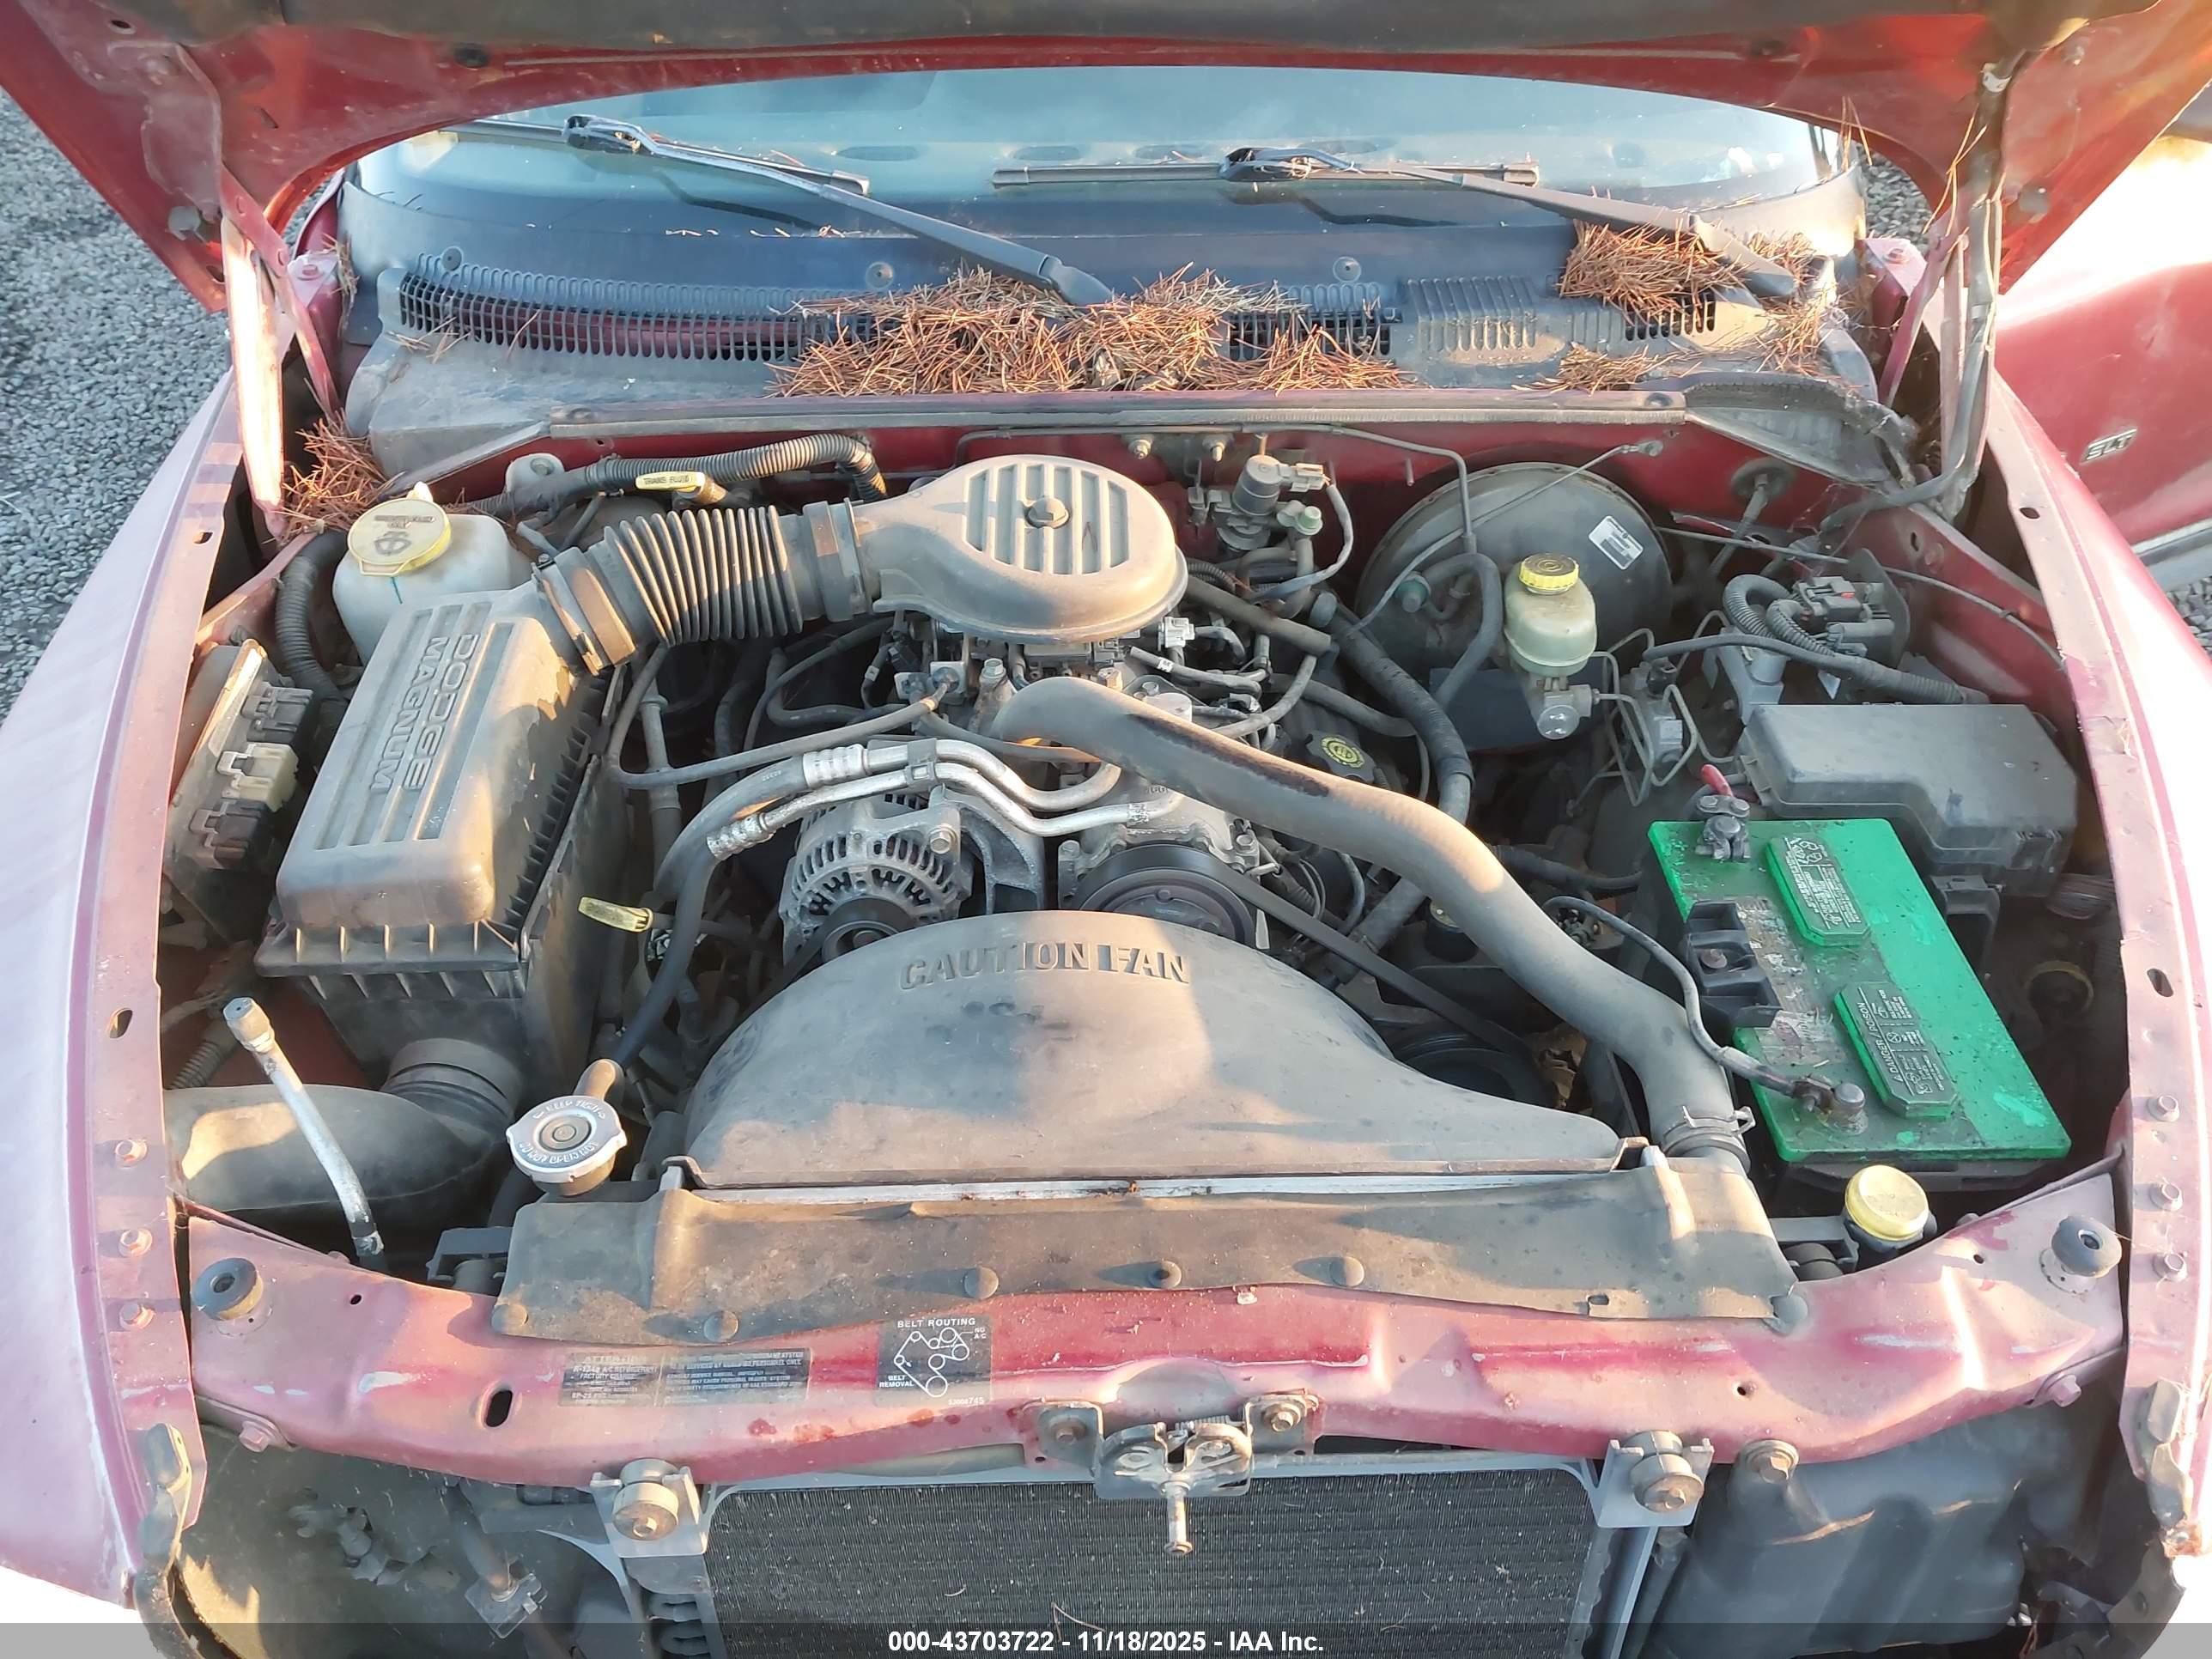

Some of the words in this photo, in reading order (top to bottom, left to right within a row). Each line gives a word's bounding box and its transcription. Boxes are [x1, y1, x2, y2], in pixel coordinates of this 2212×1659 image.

[369, 636, 450, 794] MAGNUM
[402, 634, 481, 791] DODGE
[901, 941, 1091, 990] CAUTION
[1096, 943, 1190, 985] FAN
[1856, 1002, 1879, 1032] POISON
[1875, 1038, 1899, 1074] DANGER
[896, 1319, 924, 1328] BELT
[927, 1317, 975, 1328] ROUTING
